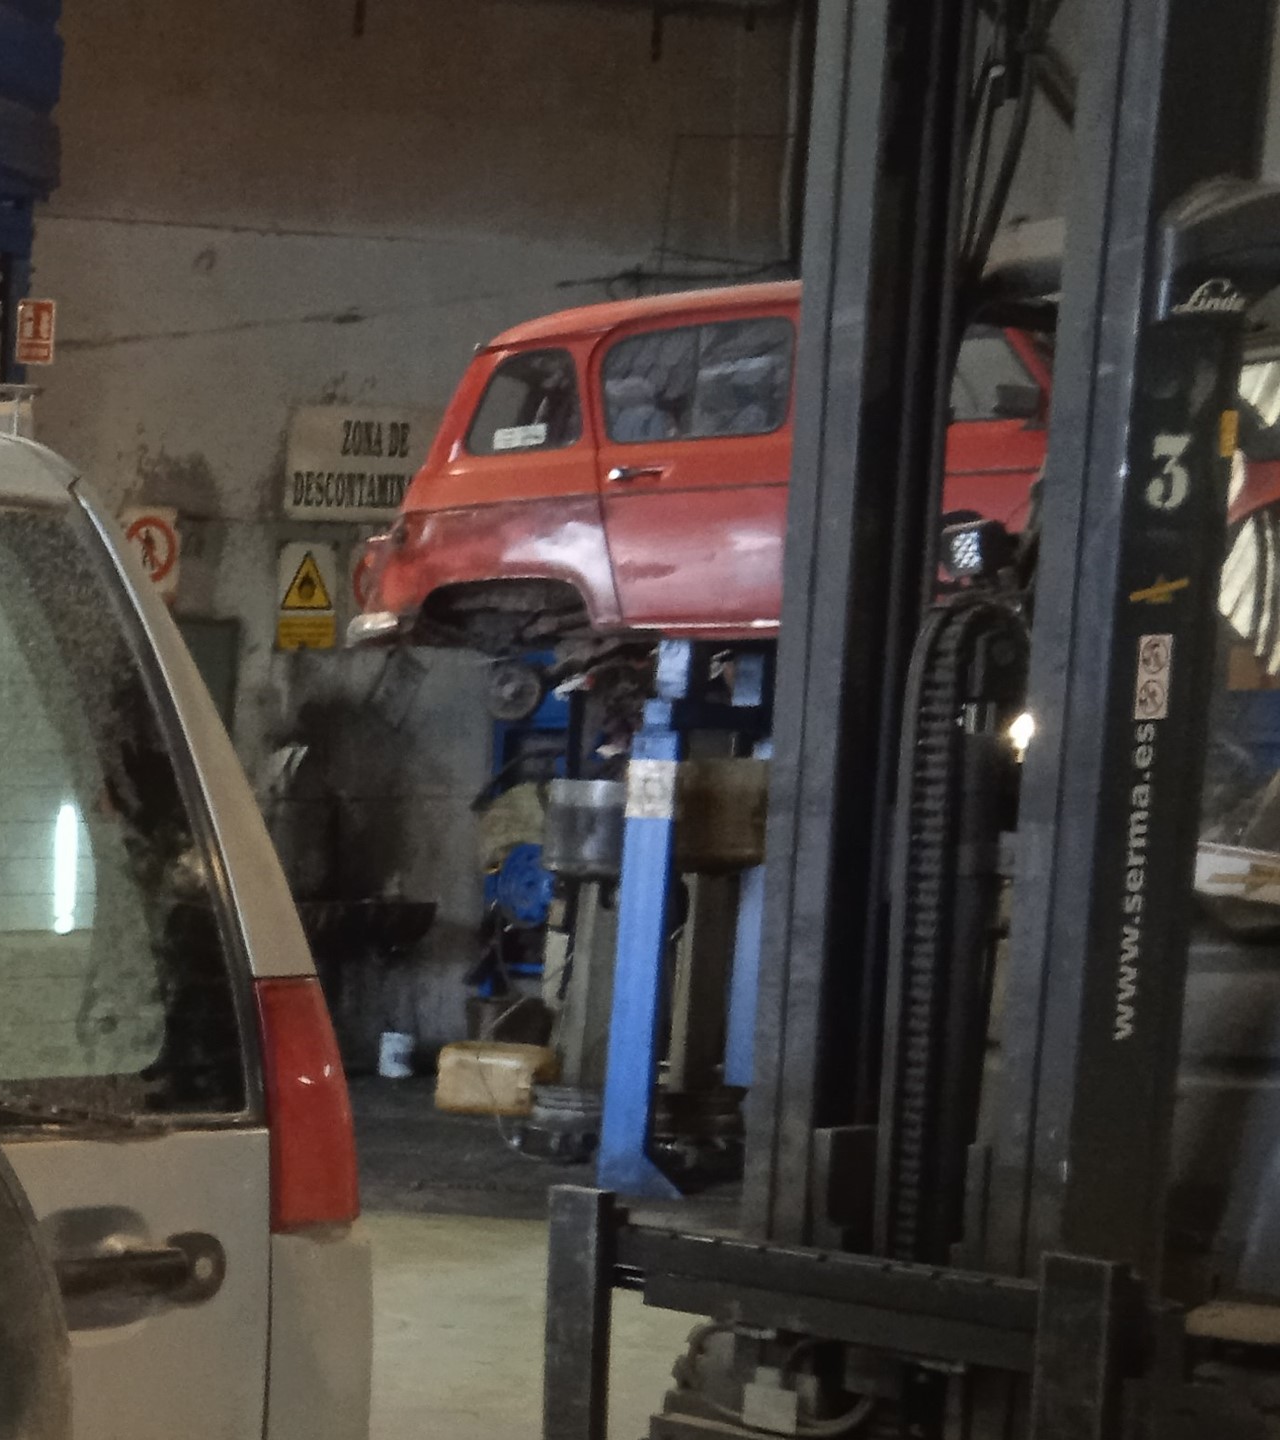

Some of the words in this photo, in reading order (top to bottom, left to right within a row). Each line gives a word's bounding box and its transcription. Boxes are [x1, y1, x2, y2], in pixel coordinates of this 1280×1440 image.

[341, 419, 382, 457] ZONA
[387, 421, 410, 458] DE
[1146, 433, 1190, 510] 3
[1112, 722, 1157, 1042] www.serma.es
